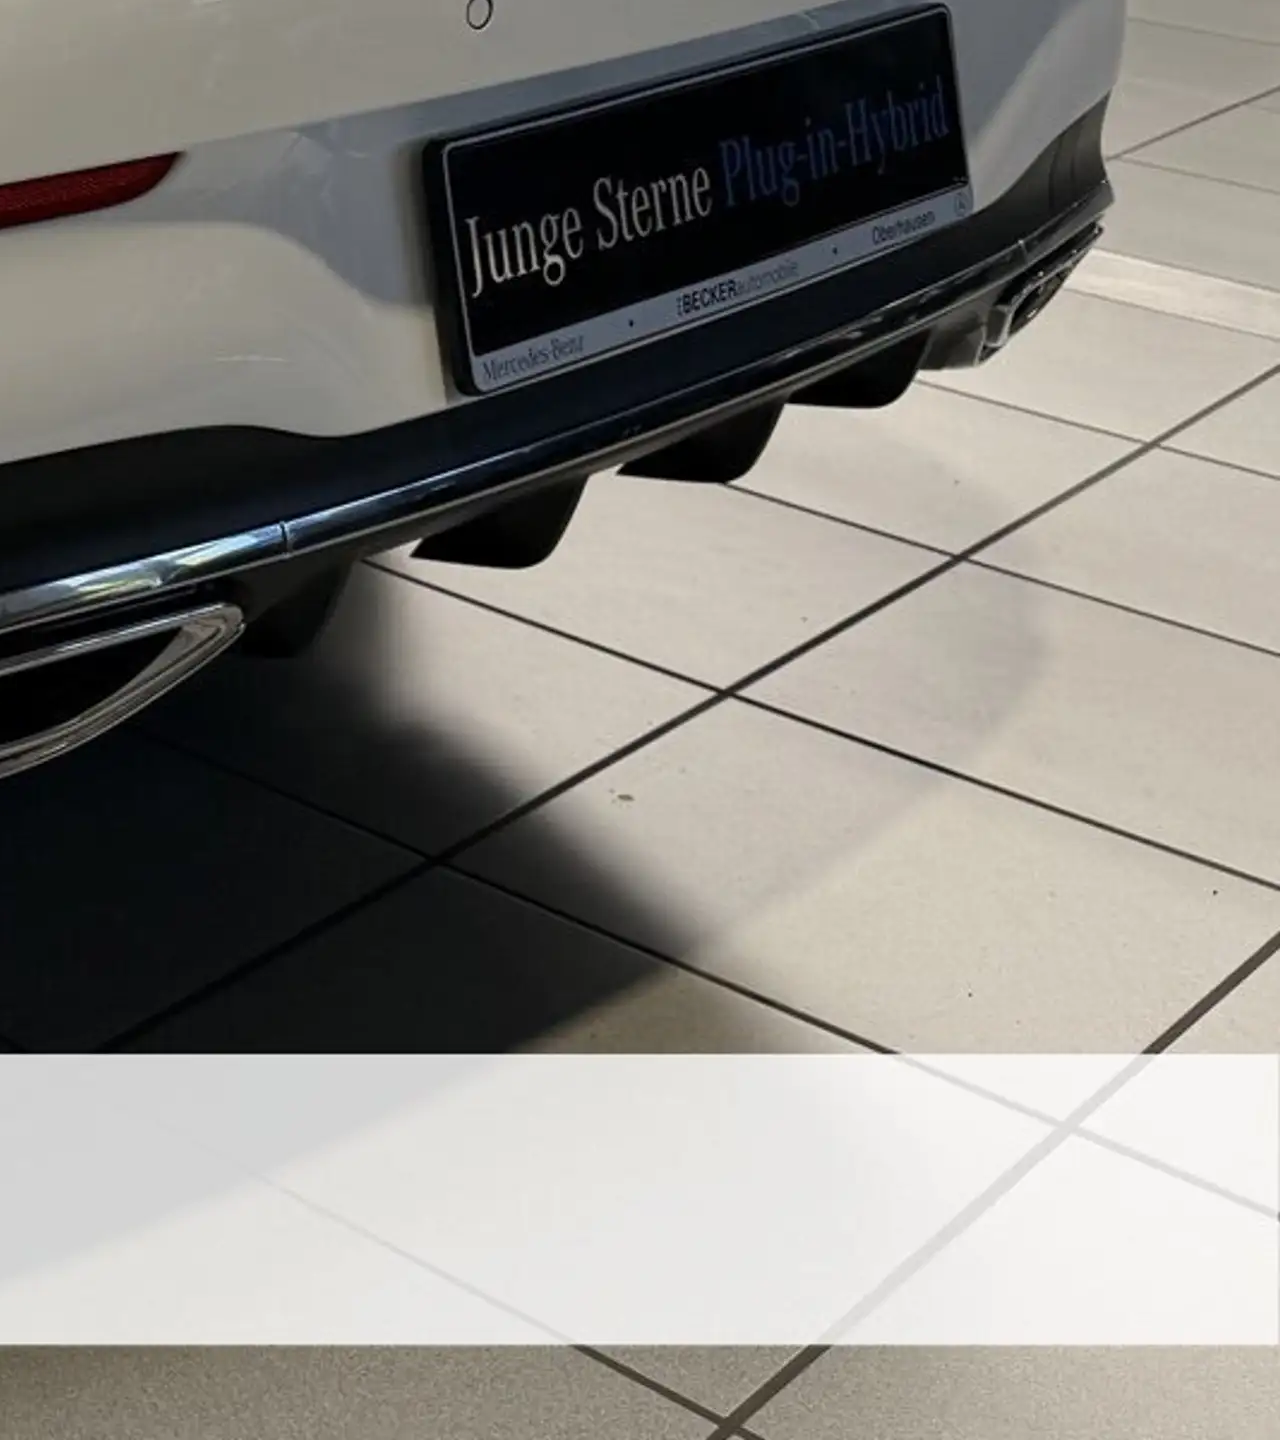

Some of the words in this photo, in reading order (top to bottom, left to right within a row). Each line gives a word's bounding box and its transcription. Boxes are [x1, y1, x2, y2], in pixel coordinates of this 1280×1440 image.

[464, 206, 585, 298] Junge
[592, 165, 713, 250] Sterne
[718, 76, 950, 207] Plug-in-Hybrid
[871, 210, 936, 247] Oberhausen
